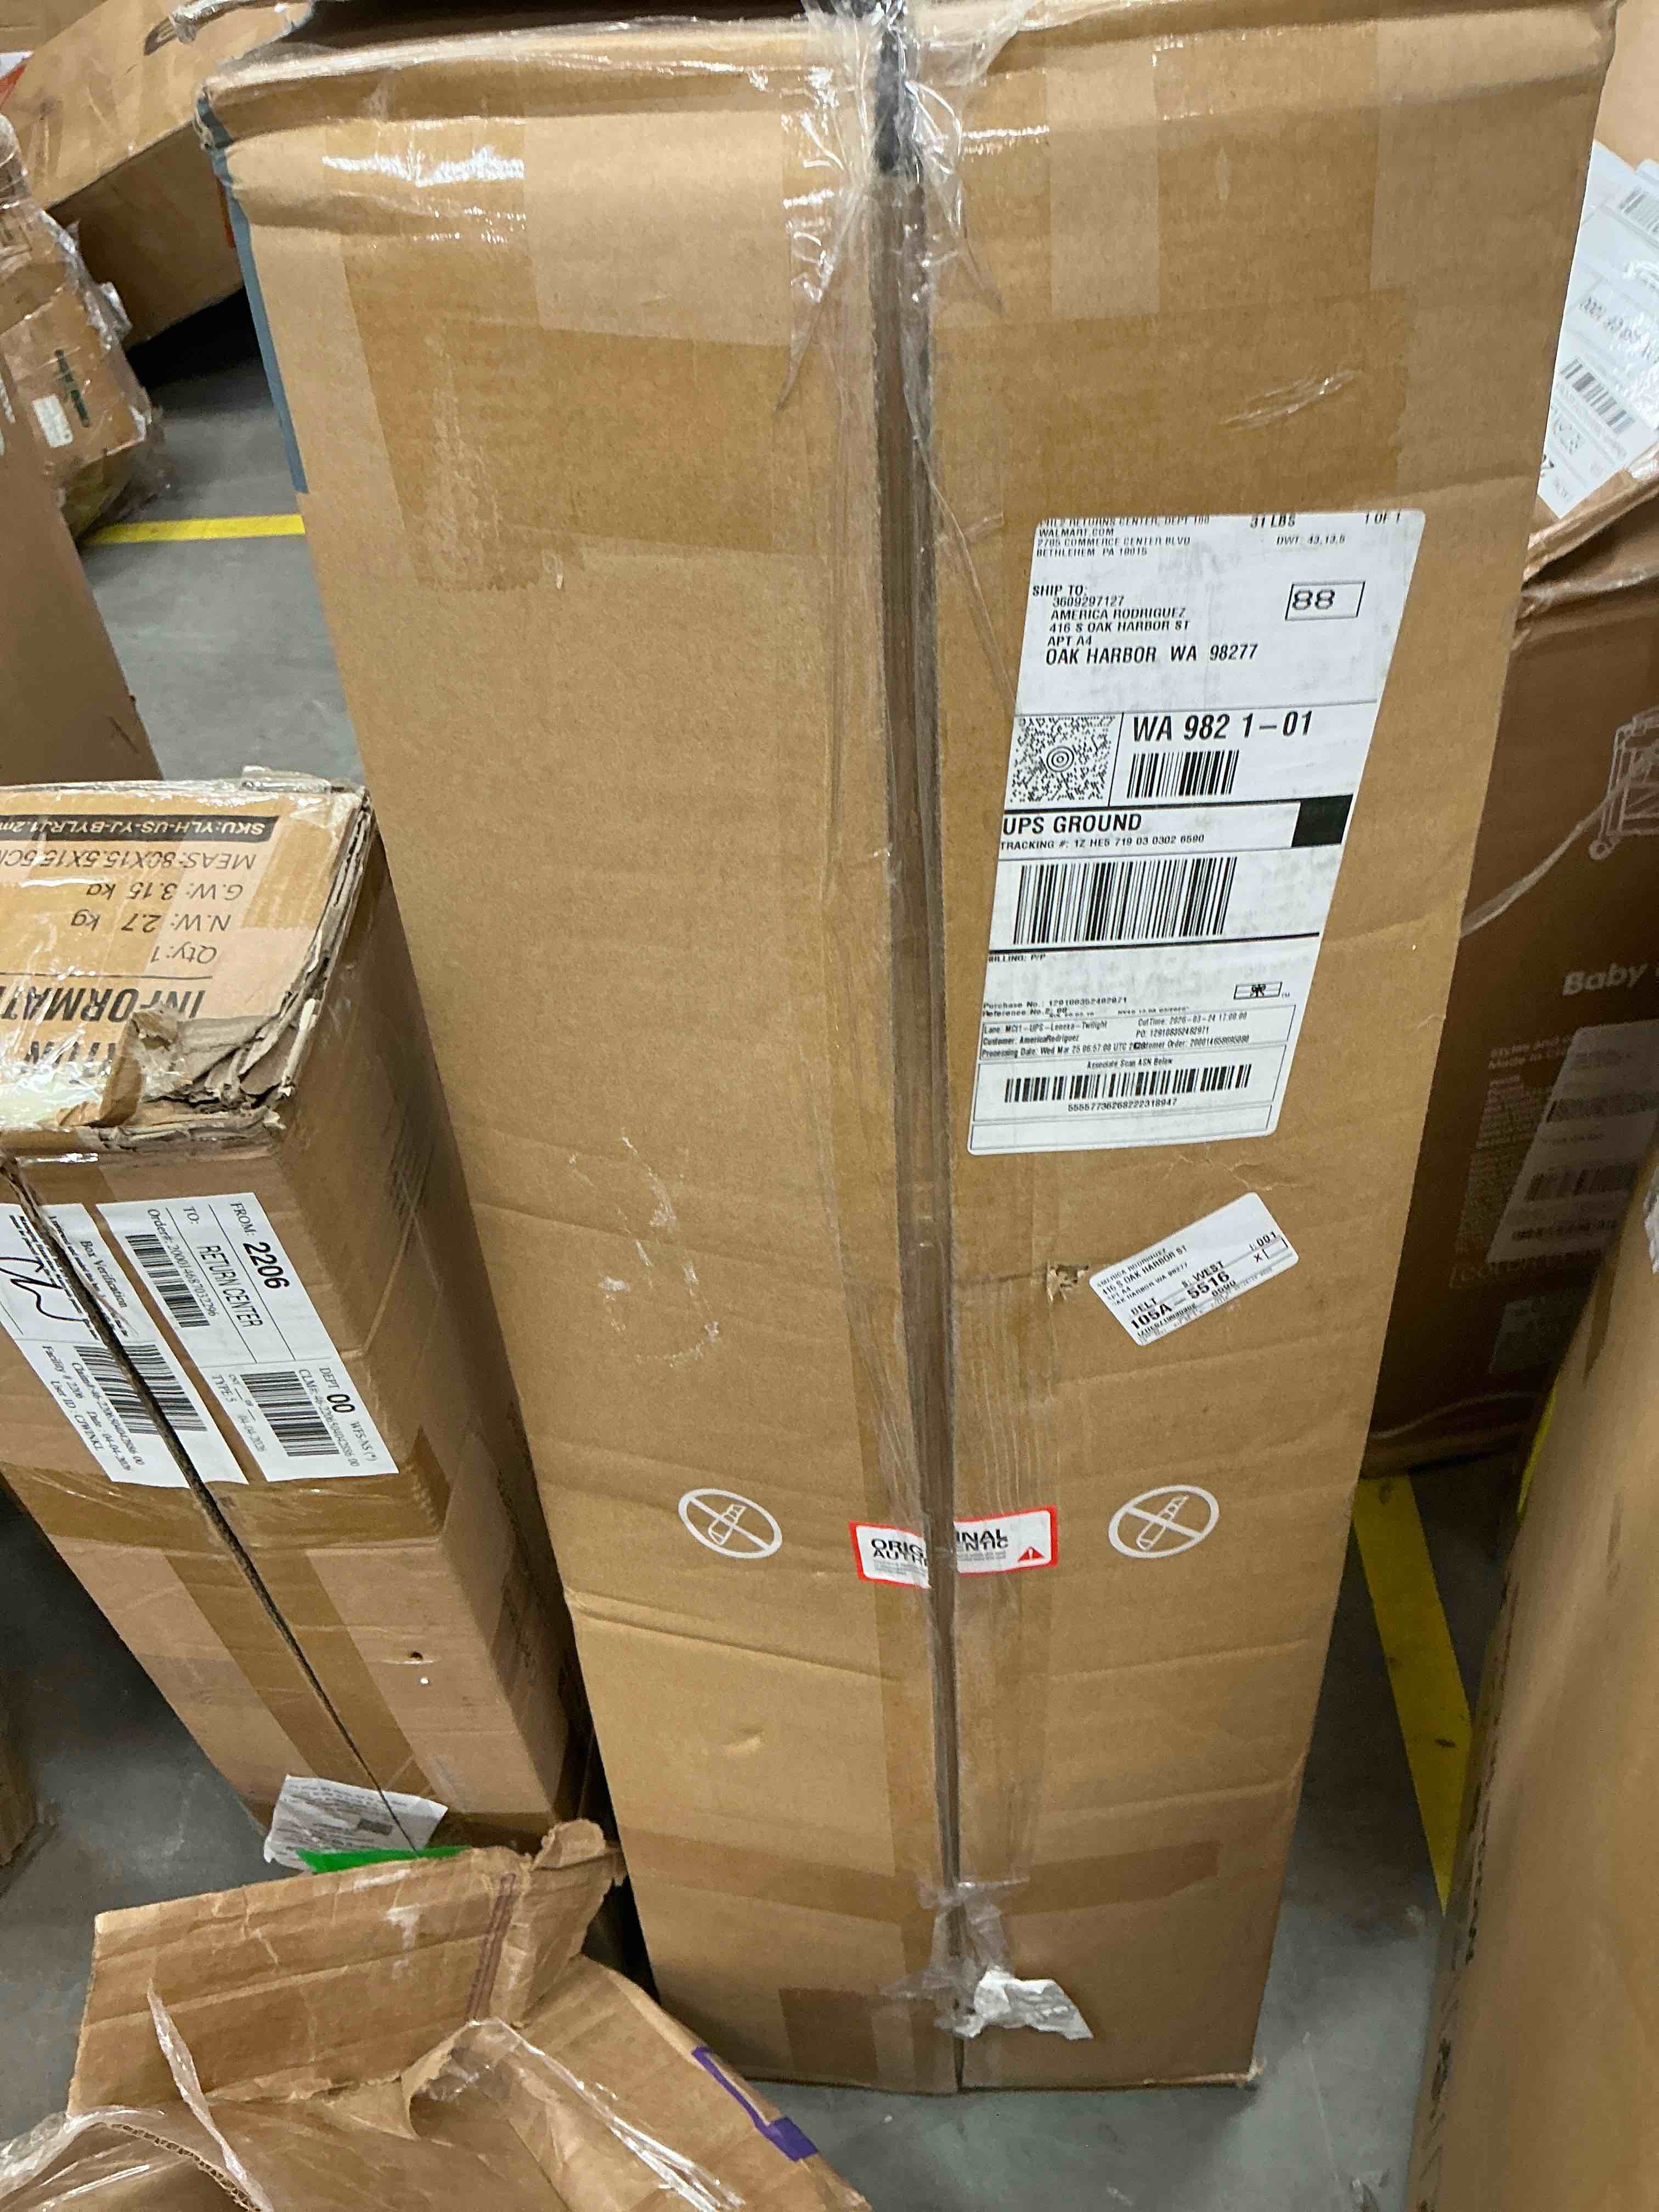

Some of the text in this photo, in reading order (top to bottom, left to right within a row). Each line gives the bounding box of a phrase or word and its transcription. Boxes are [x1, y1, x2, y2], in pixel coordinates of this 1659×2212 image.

[1270, 514, 1296, 528] LBS
[1036, 549, 1096, 557] BETHLEHEM
[1032, 584, 1088, 597] SHIP TO:
[1292, 588, 1335, 610] 88
[1052, 596, 1125, 608] 3609297127
[1051, 607, 1187, 621] AMERICA RODRIGUEZ
[1049, 620, 1190, 633] 416 S OAK HARBOR ST
[1047, 635, 1093, 647] APT A4
[1045, 644, 1259, 666] OAK HARBOR WA 98277
[1132, 714, 1173, 743] WA
[1183, 713, 1231, 741] 982
[1002, 812, 1142, 836] UPS GROUND
[1000, 840, 1054, 850] TRACKING
[1074, 839, 1086, 848] 1Z
[1090, 838, 1110, 848] HE5
[1114, 837, 1133, 847] 719
[1136, 836, 1149, 846] 03
[1152, 835, 1177, 845] 0302
[129, 882, 178, 901] 3.15
[186, 884, 244, 901] G.W:
[70, 910, 232, 933] N.W: 2.7 kg
[1562, 963, 1646, 997] Baby
[982, 1009, 1026, 1018] Reference
[983, 1001, 1023, 1009] Purchase
[1040, 1046, 1055, 1055] Wed
[1057, 1046, 1070, 1054] Mar
[1137, 1057, 1152, 1067] ASN
[230, 1203, 290, 1289] FROM: 2206
[183, 1206, 263, 1327] TO: RETURN CENTER
[1192, 1261, 1224, 1282] WEST
[1256, 1231, 1278, 1247] 001
[80, 1240, 97, 1257] Box
[94, 1260, 127, 1308] Verification
[1131, 1304, 1172, 1329] 105A
[1187, 1271, 1229, 1299] 5516
[42, 1346, 66, 1373] Facility
[66, 1382, 85, 1399] 2206
[86, 1411, 102, 1427] Date
[319, 1367, 340, 1389] DEPT
[50, 1381, 66, 1397] User
[63, 1399, 76, 1409] ID
[326, 1393, 356, 1413] 00
